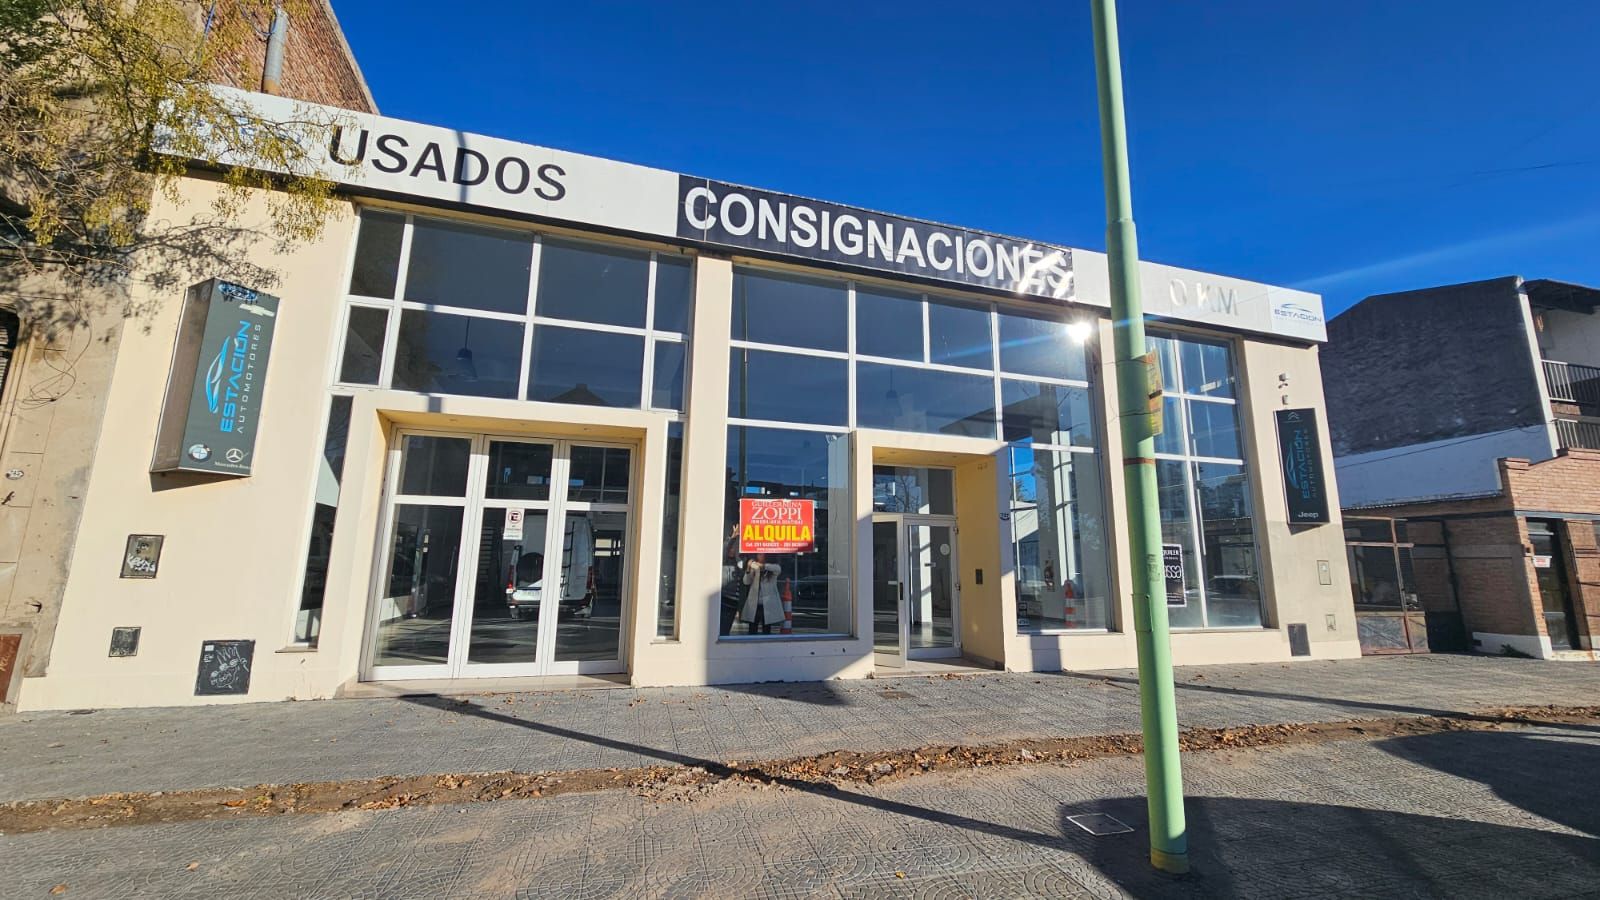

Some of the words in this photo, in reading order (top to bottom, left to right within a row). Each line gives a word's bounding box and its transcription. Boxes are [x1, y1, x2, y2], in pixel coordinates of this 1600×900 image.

[329, 125, 567, 201] USADOS
[684, 186, 1070, 291] CONSIGNACIONES
[1196, 283, 1239, 317] KM
[237, 324, 262, 434] AUTOMOTORES
[751, 507, 803, 520] ZOPPI
[1298, 511, 1319, 519] Jeep
[743, 524, 811, 542] ALQUILA
